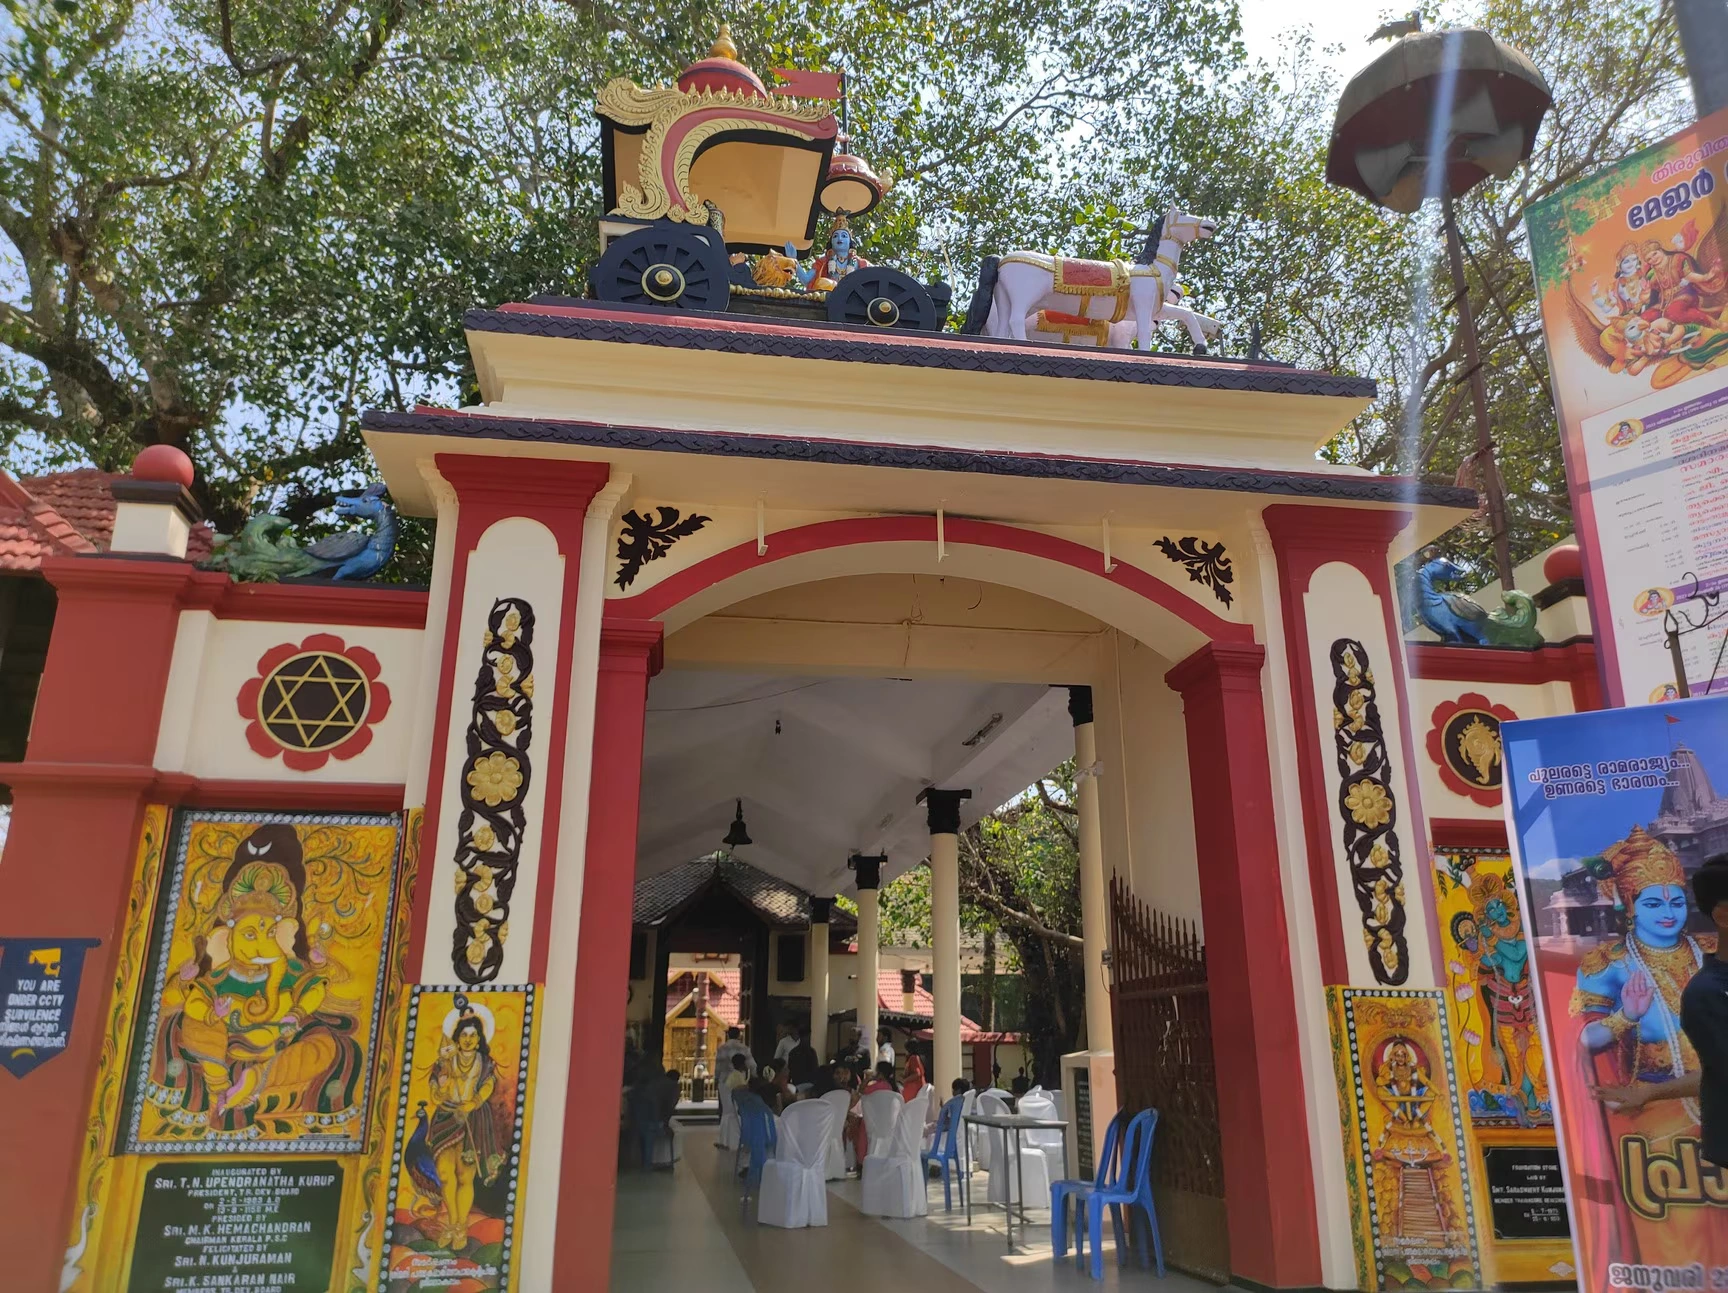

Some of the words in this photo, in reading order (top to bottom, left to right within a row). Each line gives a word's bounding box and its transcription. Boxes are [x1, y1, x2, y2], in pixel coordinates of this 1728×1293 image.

[1528, 762, 1593, 784] പുലരട്ടെ
[1544, 779, 1607, 799] ഉണരട്ടെ
[18, 979, 37, 991] YOU
[40, 979, 61, 992] ARE
[8, 993, 38, 1006] UNDER
[39, 994, 65, 1006] CCTV
[4, 1008, 62, 1021] SURVILENCE
[211, 1167, 267, 1176] INAUGURATED
[270, 1167, 282, 1175] BY
[205, 1175, 294, 1188] UPENDRANATHA
[298, 1175, 335, 1187] KURUP
[211, 1214, 253, 1223] PRESIDED
[255, 1214, 268, 1222] BY
[217, 1221, 312, 1235] HEMACHANDRAN
[184, 1235, 227, 1245] CHAIRMAN
[230, 1235, 263, 1243] KERALA
[202, 1244, 254, 1253] FELICITATED
[256, 1243, 269, 1251] BY
[212, 1252, 292, 1265] KUNJURAMAN
[202, 1273, 266, 1287] SANKARAN
[269, 1272, 296, 1285] NAIR
